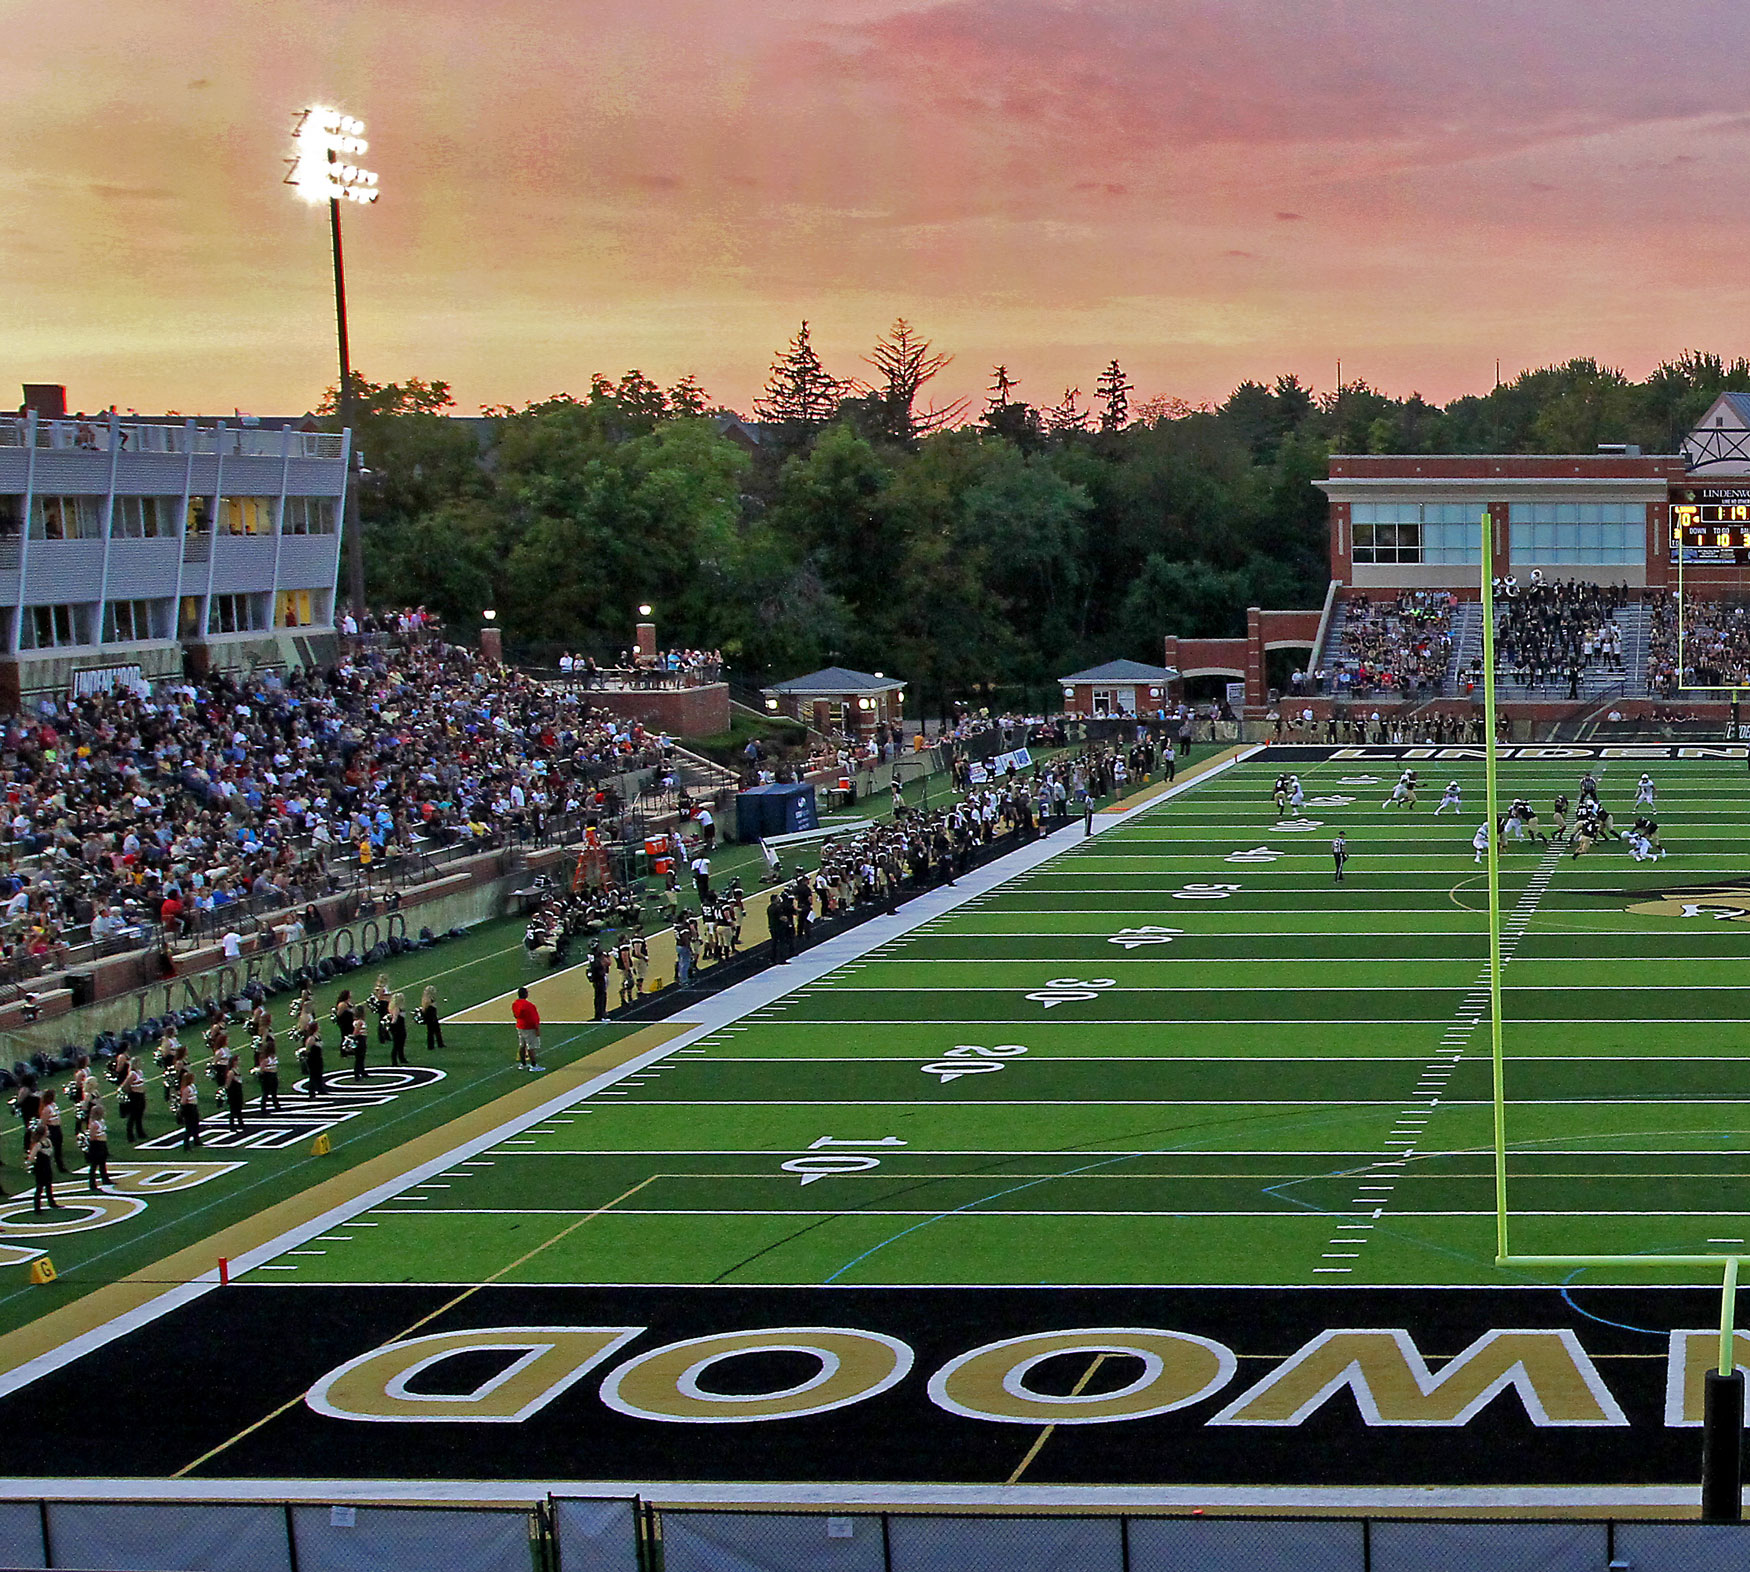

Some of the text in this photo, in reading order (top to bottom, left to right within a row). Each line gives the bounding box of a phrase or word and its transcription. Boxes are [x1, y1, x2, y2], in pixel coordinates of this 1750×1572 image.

[1718, 505, 1747, 520] 1:19
[1689, 527, 1706, 535] DOWN
[1713, 527, 1721, 535] TO
[1717, 534, 1730, 547] 10
[1172, 884, 1242, 899] 50
[1107, 926, 1184, 945] 40
[137, 913, 406, 1023] LINDENWOOD
[1025, 978, 1117, 1001] 30
[920, 1044, 1029, 1074] 20
[781, 1136, 909, 1173] 10
[40, 1261, 53, 1277] G
